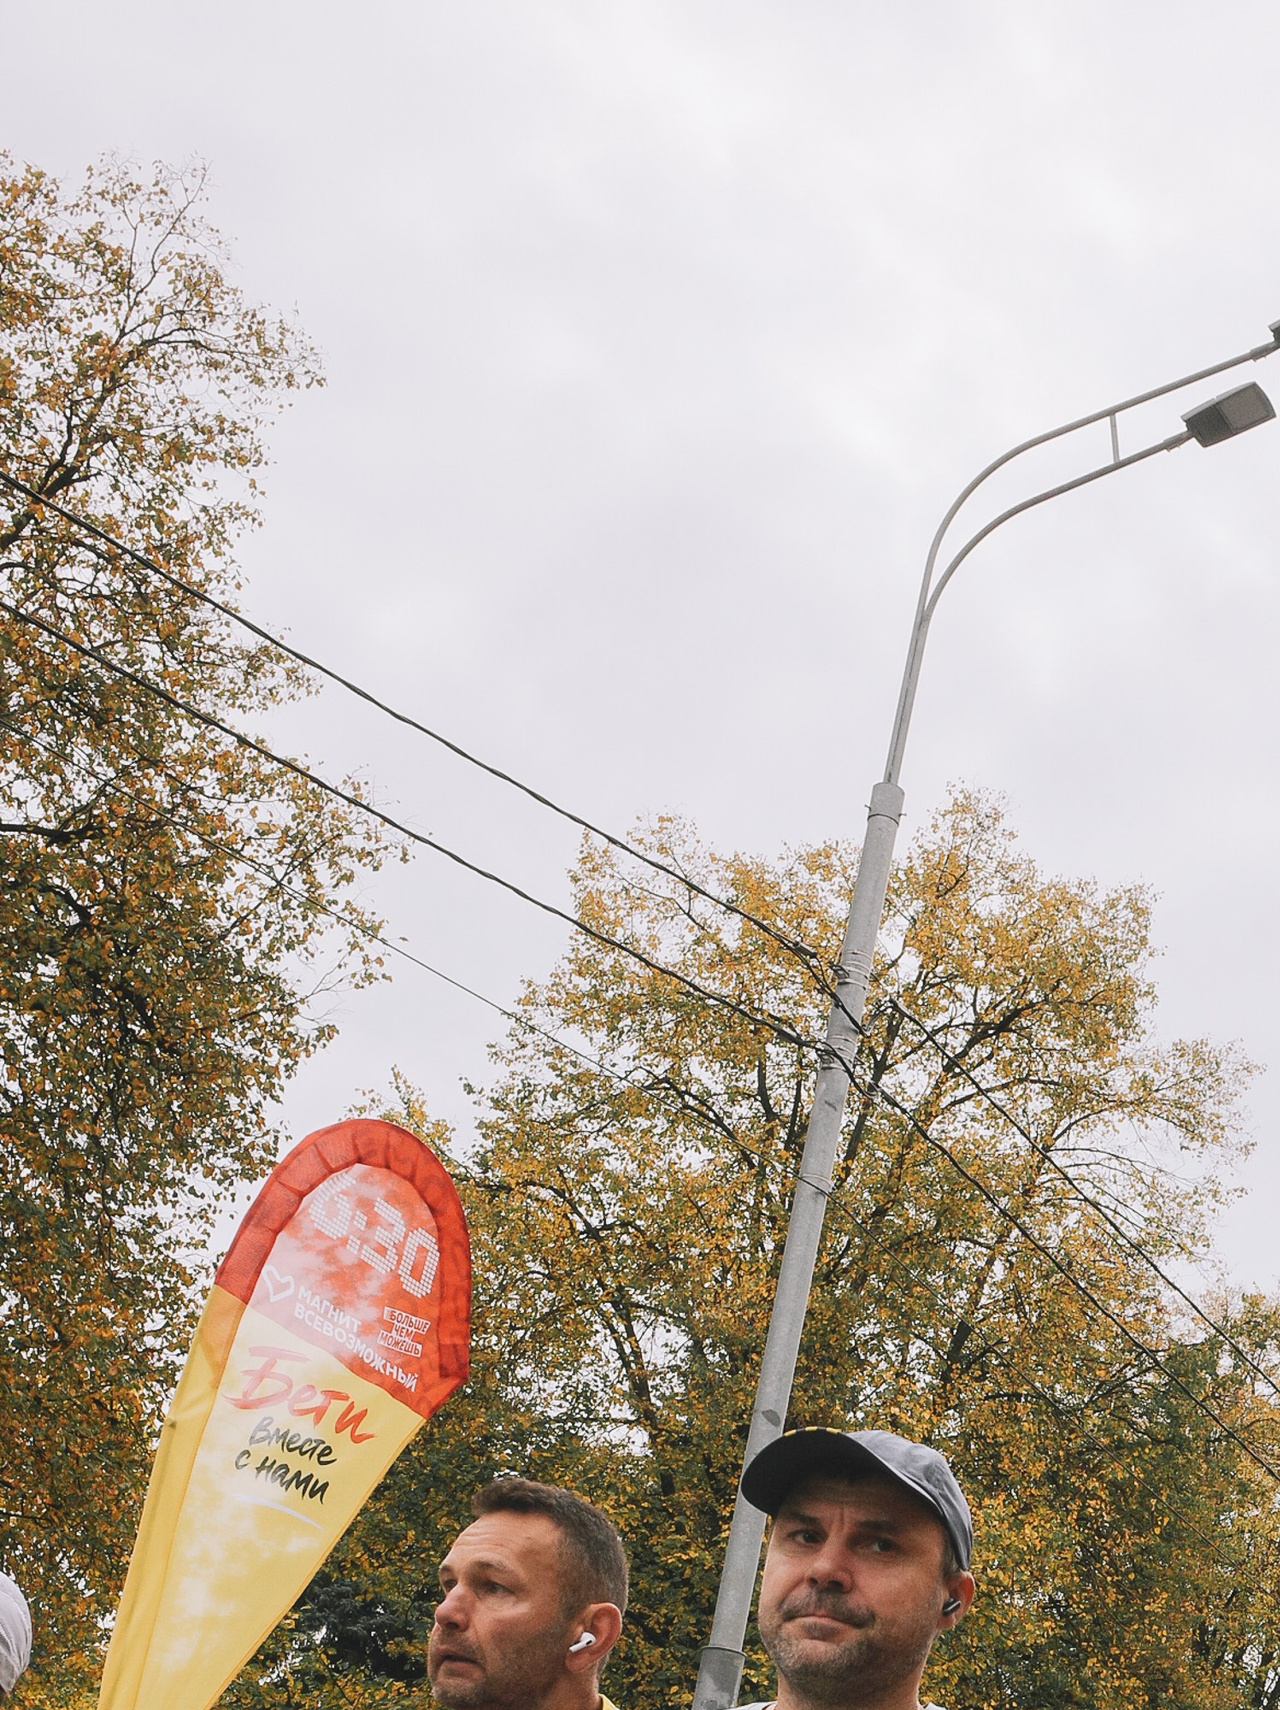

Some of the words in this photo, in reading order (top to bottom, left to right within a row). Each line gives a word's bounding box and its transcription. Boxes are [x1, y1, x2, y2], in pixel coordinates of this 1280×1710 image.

[308, 1172, 441, 1299] 6:30
[298, 1285, 362, 1333] МАГНИТ
[389, 1309, 431, 1333] БОЛЬШЕ
[393, 1322, 415, 1341] ЧЕМ
[294, 1302, 420, 1393] ВСЕВОЗМОЖНЫЙ
[379, 1331, 421, 1356] МОЖЕШЬ
[222, 1345, 377, 1444] Беги
[234, 1449, 252, 1470] с
[255, 1455, 330, 1505] нами
